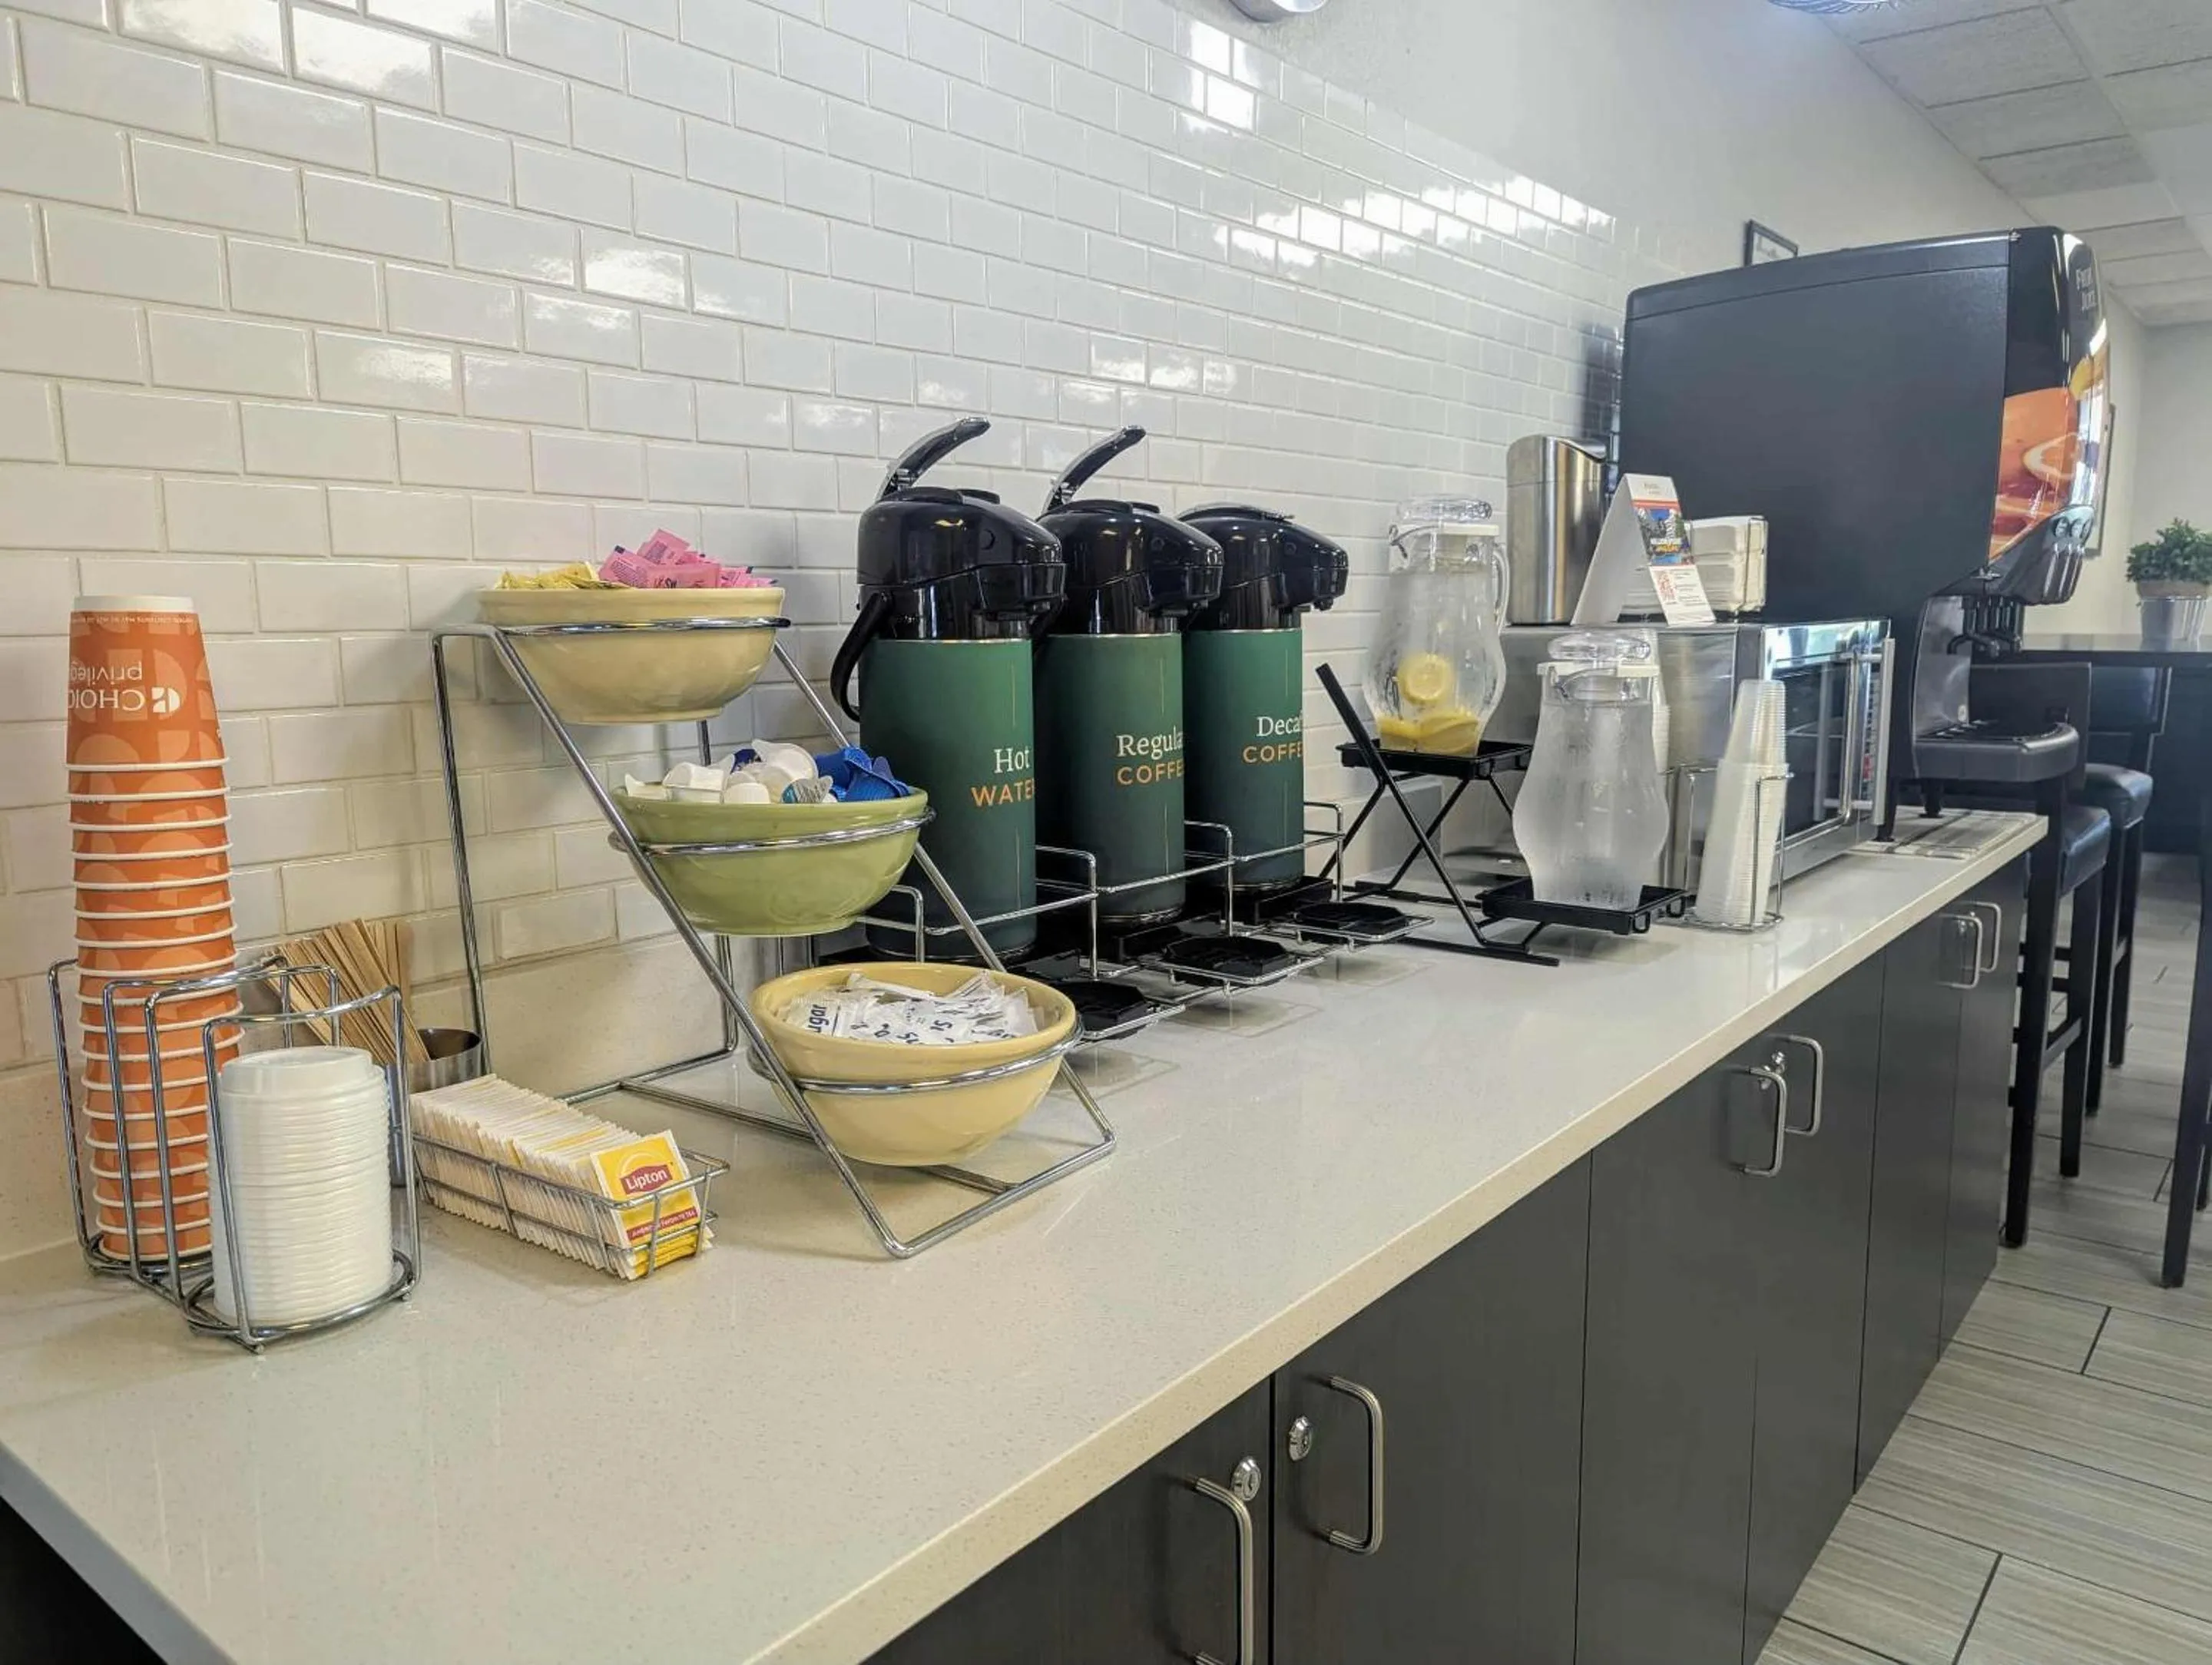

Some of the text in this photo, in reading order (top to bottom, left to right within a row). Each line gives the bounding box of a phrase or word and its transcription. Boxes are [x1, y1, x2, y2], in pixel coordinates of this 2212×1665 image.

[1256, 713, 1303, 737] Deca
[993, 746, 1030, 773] Hot
[625, 1169, 668, 1190] Lipton
